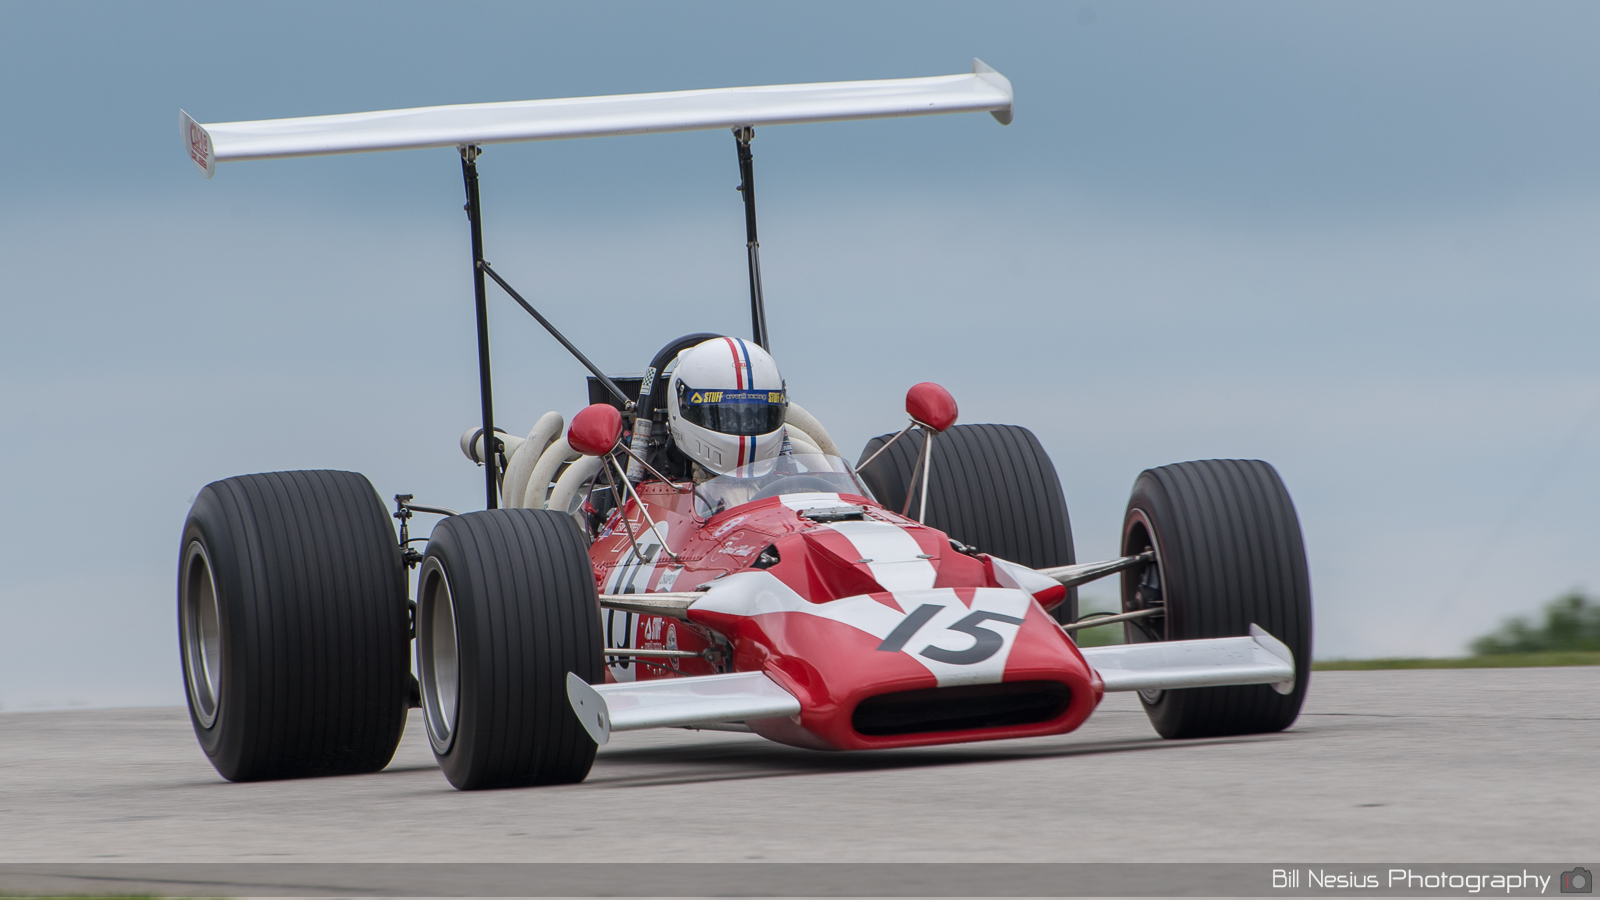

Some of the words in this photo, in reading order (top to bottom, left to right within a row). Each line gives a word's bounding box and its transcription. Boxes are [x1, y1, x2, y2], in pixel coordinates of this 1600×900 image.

[703, 392, 724, 403] STUFF
[747, 392, 767, 401] racing
[876, 603, 1027, 665] 15
